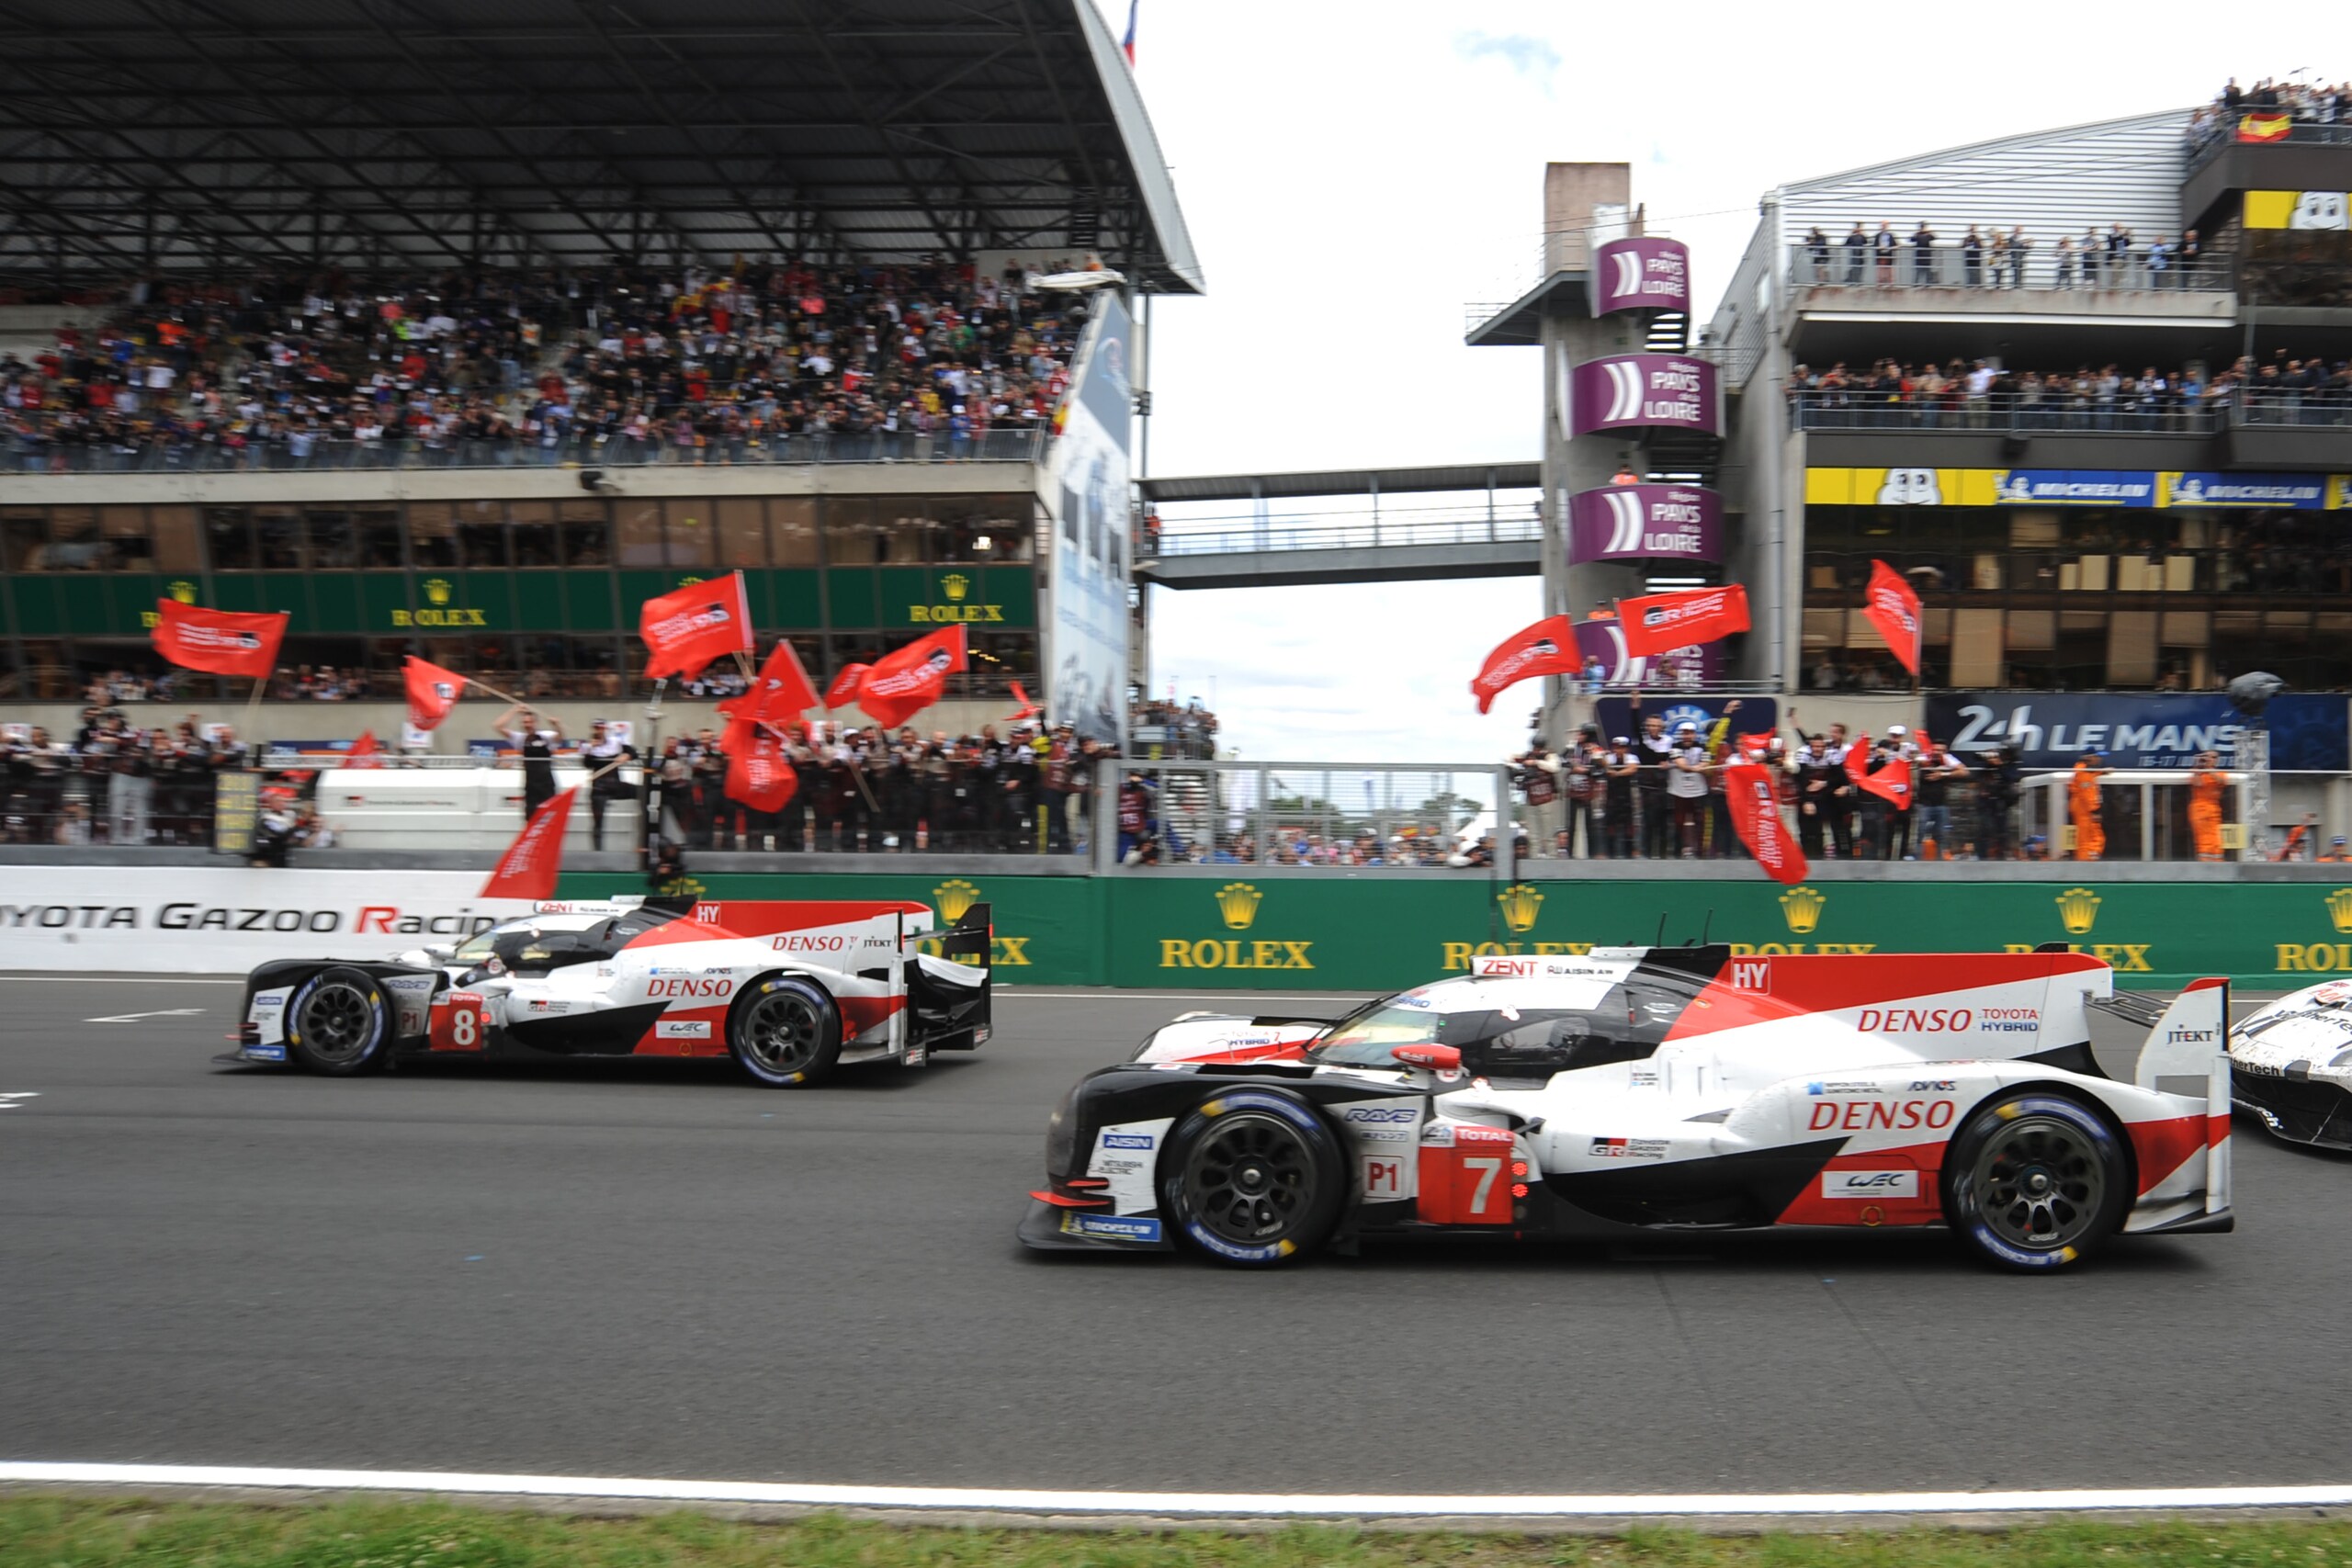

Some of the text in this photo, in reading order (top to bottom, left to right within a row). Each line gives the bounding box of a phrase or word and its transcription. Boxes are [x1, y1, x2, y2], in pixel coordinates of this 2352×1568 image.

[1642, 280, 1685, 298] LOIRE
[1644, 400, 1702, 422] LOIRE
[1644, 533, 1702, 553] LOIRE
[390, 609, 487, 626] ROLEX
[909, 604, 1005, 622] ROLEX
[1950, 705, 2246, 751] 24h LE MANS
[0, 905, 139, 929] YOTA
[355, 906, 519, 934] Racin
[697, 906, 719, 922] HY
[773, 936, 843, 952] DENSO
[1159, 939, 1316, 969] ROLEX
[1482, 959, 1538, 976] ZENT
[1733, 963, 1768, 988] HY
[647, 979, 733, 997] DENSO
[1857, 1009, 1972, 1032] DENSO
[1983, 1009, 2039, 1020] TOYOTA
[453, 1010, 476, 1045] 8
[1981, 1022, 2039, 1032] HYBRID
[2166, 1030, 2213, 1044] JTEKT
[1345, 1109, 1418, 1122] RAYS
[1807, 1100, 1955, 1131] DENSO
[1105, 1136, 1151, 1147] AISIN
[1457, 1128, 1512, 1142] TOTAL
[1368, 1162, 1397, 1191] P1
[1463, 1157, 1502, 1214] 7
[1846, 1173, 1905, 1187] WEC
